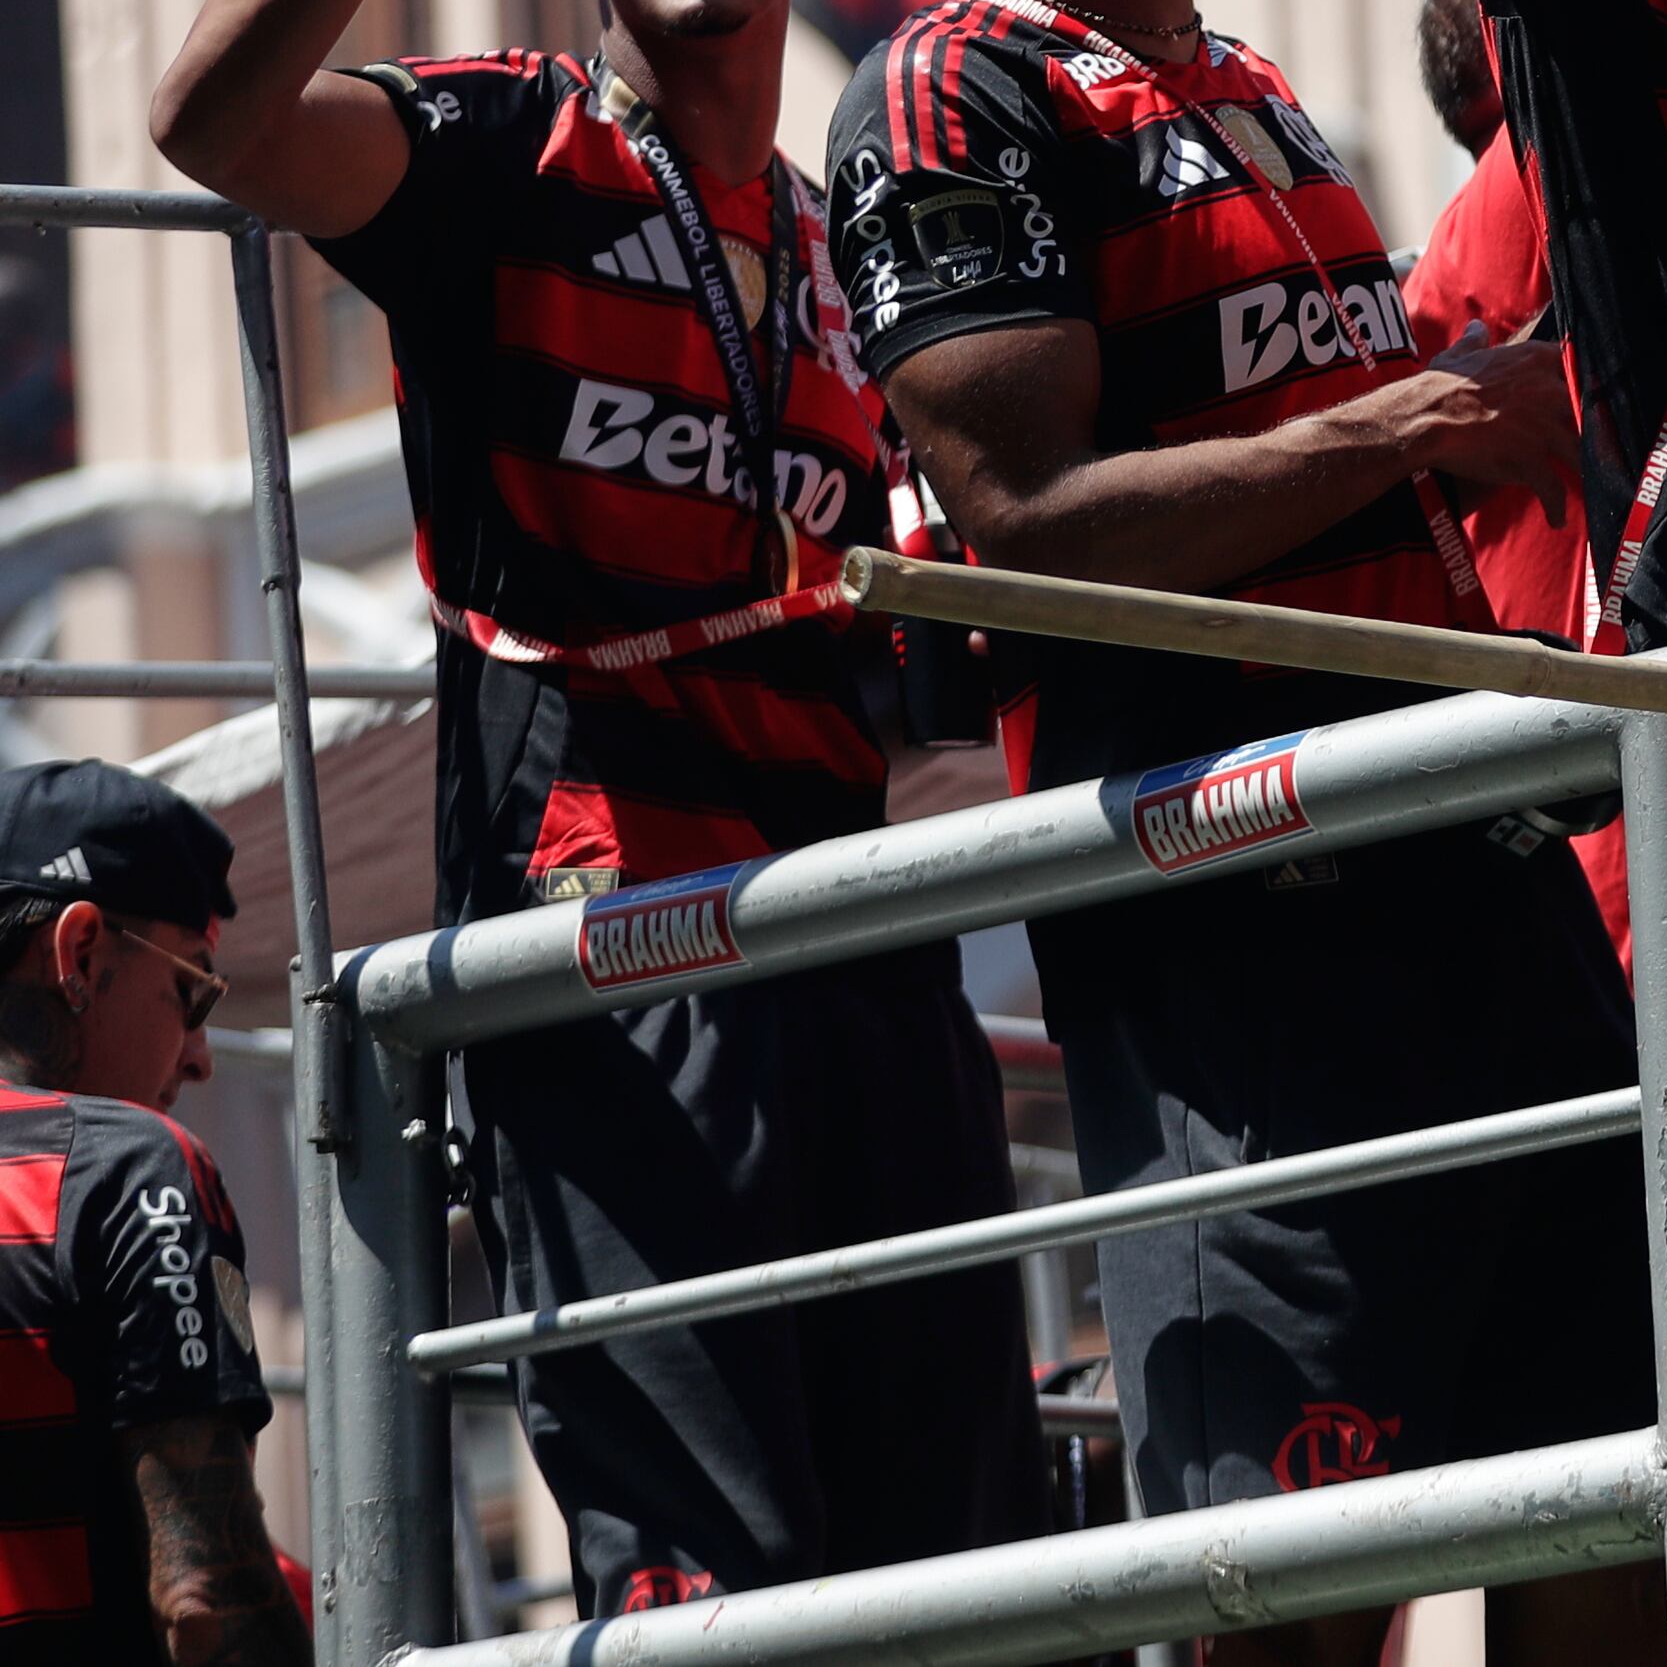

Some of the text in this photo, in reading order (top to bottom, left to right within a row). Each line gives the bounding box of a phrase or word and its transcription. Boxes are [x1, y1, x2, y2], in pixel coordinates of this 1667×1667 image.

[638, 133, 763, 438] CONMEBOL LIBERTADORES
[1218, 278, 1418, 393] Betan
[1433, 507, 1479, 598] BRAHMA
[1601, 540, 1643, 626] BRAHMA
[1143, 764, 1295, 863] BRAHMA
[587, 899, 729, 980] BRAHMA
[138, 1185, 208, 1369] Shopee
